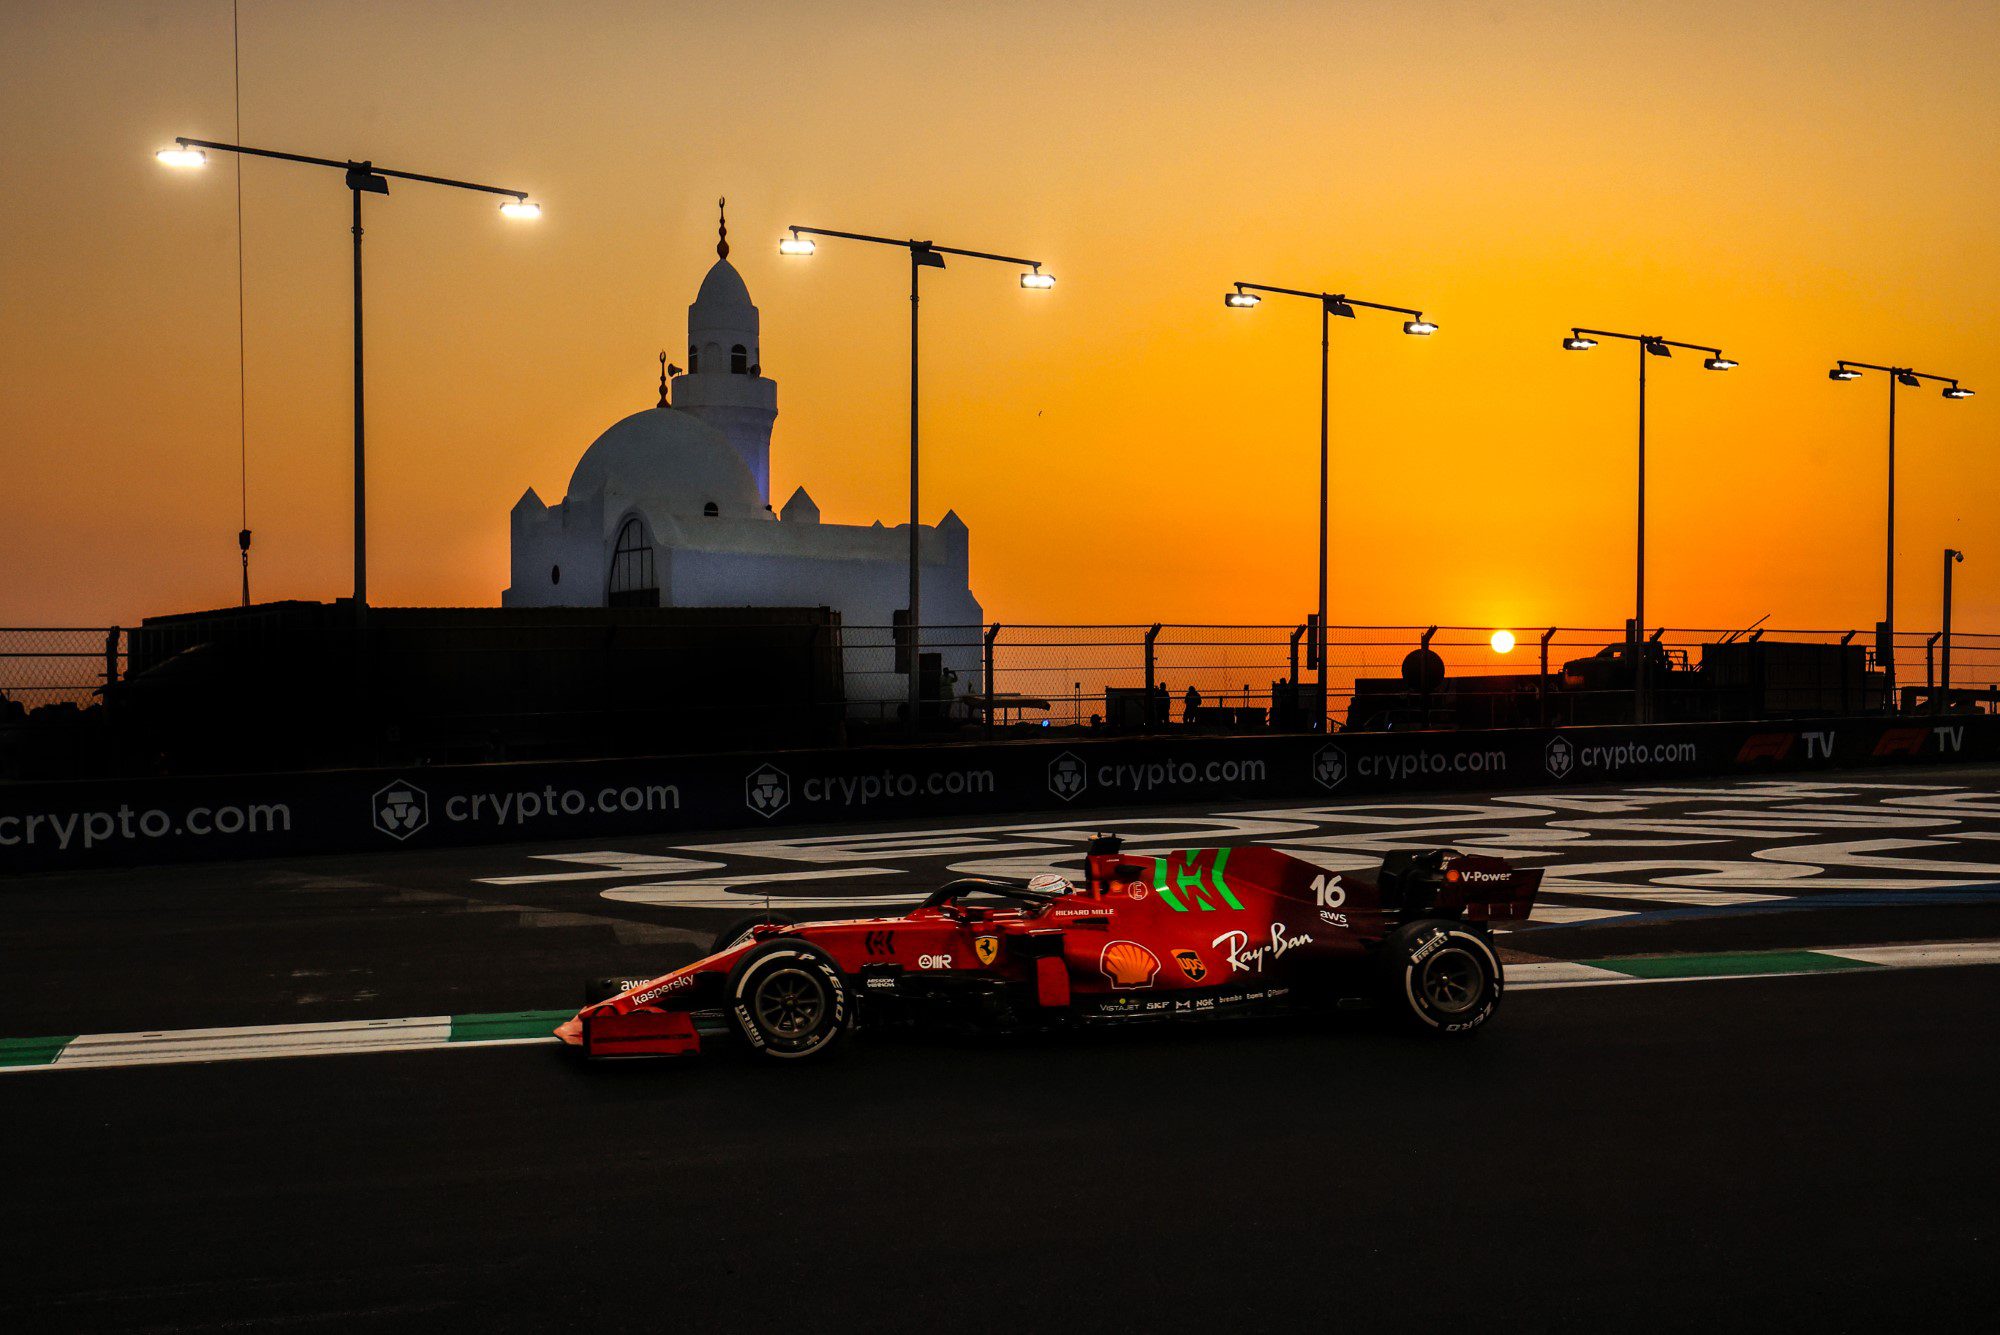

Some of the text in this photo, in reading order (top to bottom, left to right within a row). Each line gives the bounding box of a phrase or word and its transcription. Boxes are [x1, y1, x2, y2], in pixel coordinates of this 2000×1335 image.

[1802, 731, 1836, 759] TV
[1933, 726, 1964, 752] TV
[1357, 751, 1507, 780] crypto.com
[1580, 741, 1697, 770] crypto.com
[803, 771, 994, 805] crypto.com
[1097, 759, 1266, 791] crypto.com
[445, 784, 680, 825] crypto.com
[0, 803, 291, 850] crypto.com
[1309, 874, 1346, 908] 16
[1460, 871, 1512, 882] V-Power
[1055, 908, 1115, 917] RICHARD MILLE
[1319, 910, 1348, 925] aws
[1211, 922, 1314, 973] Ray-Ban
[631, 974, 695, 1006] kaspersky
